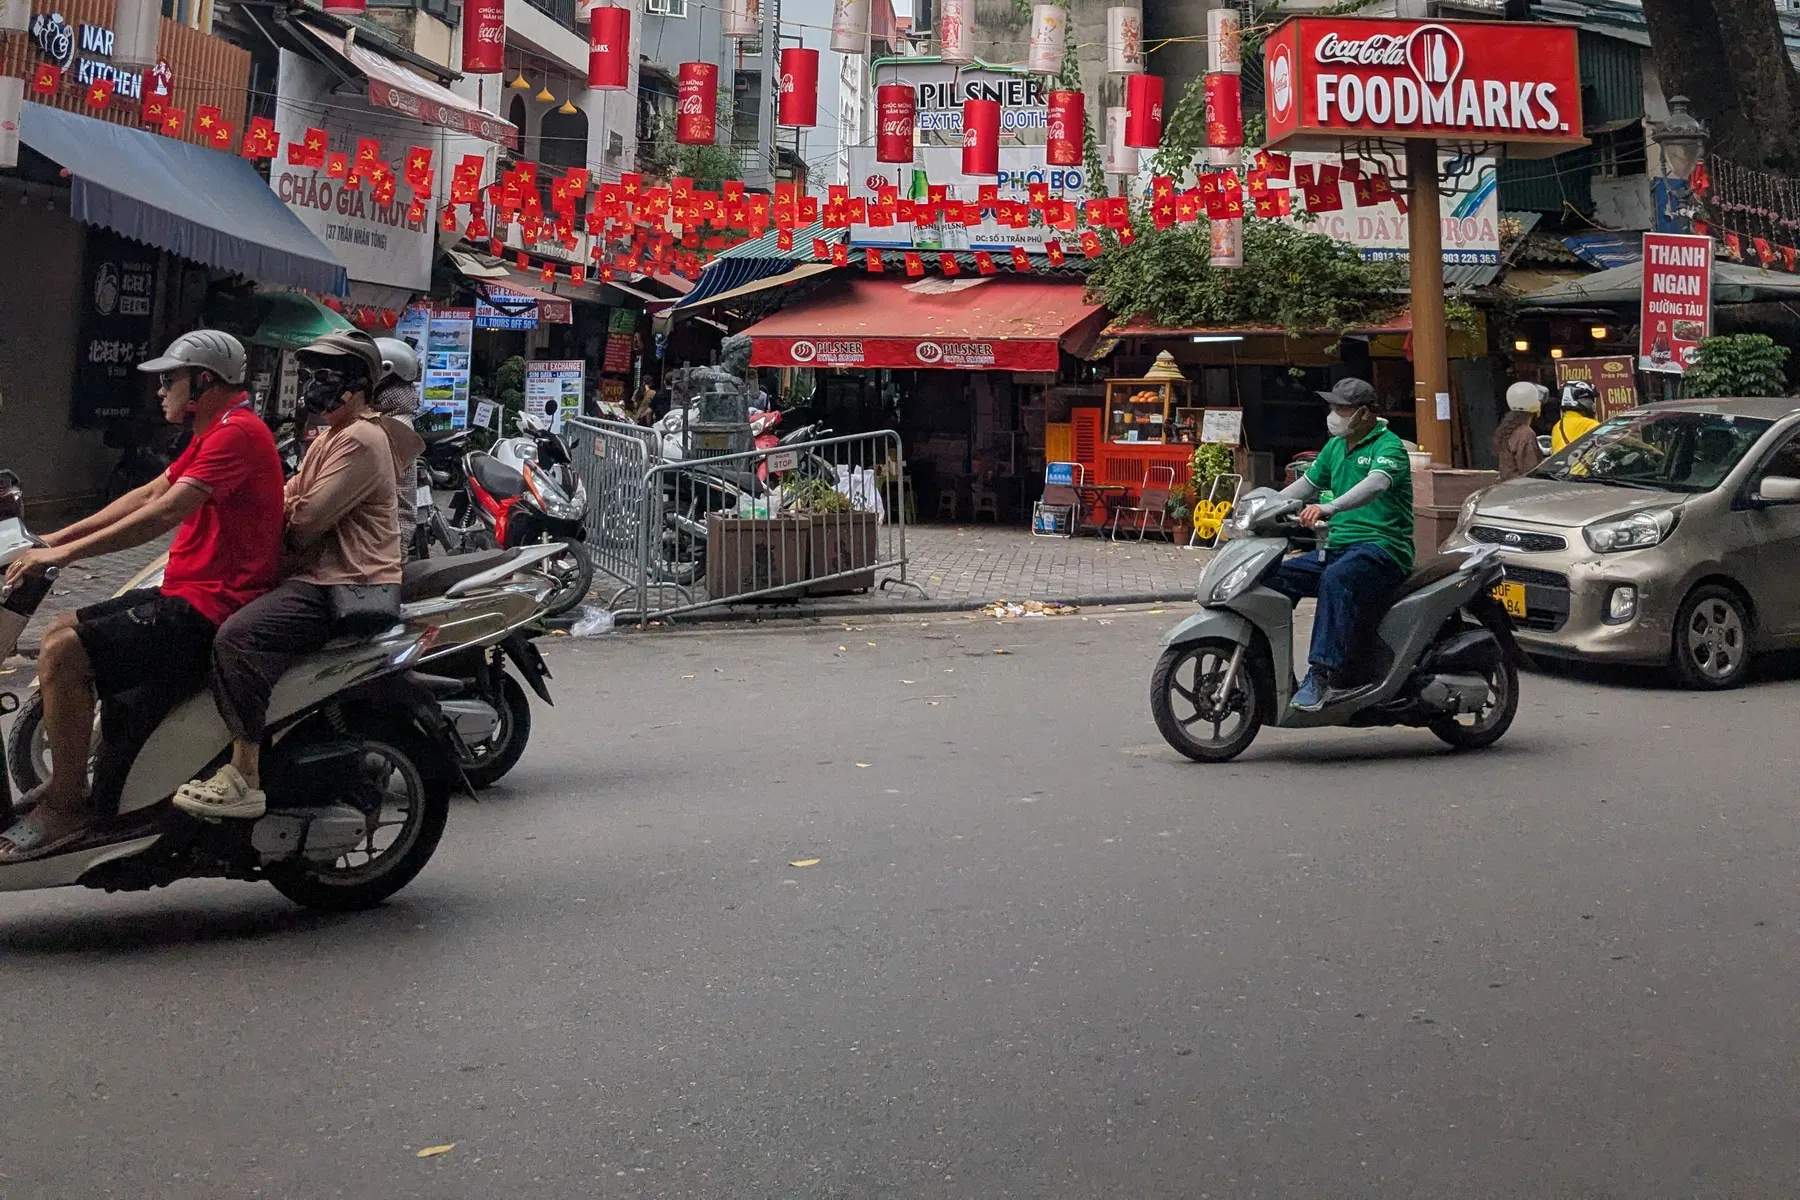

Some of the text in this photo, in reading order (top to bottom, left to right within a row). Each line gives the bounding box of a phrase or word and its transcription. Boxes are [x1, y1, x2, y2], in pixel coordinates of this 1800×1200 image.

[78, 57, 142, 99] KITCHEN
[918, 78, 1048, 109] PILSNER
[1461, 253, 1478, 264] 226
[1479, 254, 1497, 265] 363
[1649, 244, 1705, 268] THANH
[1653, 273, 1701, 297] NGAN
[478, 306, 492, 317] SIM
[1648, 298, 1703, 317] ĐƯỜNG TÀU
[475, 318, 488, 328] ALL
[488, 319, 510, 329] TOURS
[511, 319, 523, 330] OFF
[816, 341, 864, 354] PILSNER
[942, 343, 993, 356] PILSNER
[529, 362, 581, 370] MONEY EXCHANGE
[1560, 363, 1593, 381] Thanh
[773, 460, 793, 469] STOP
